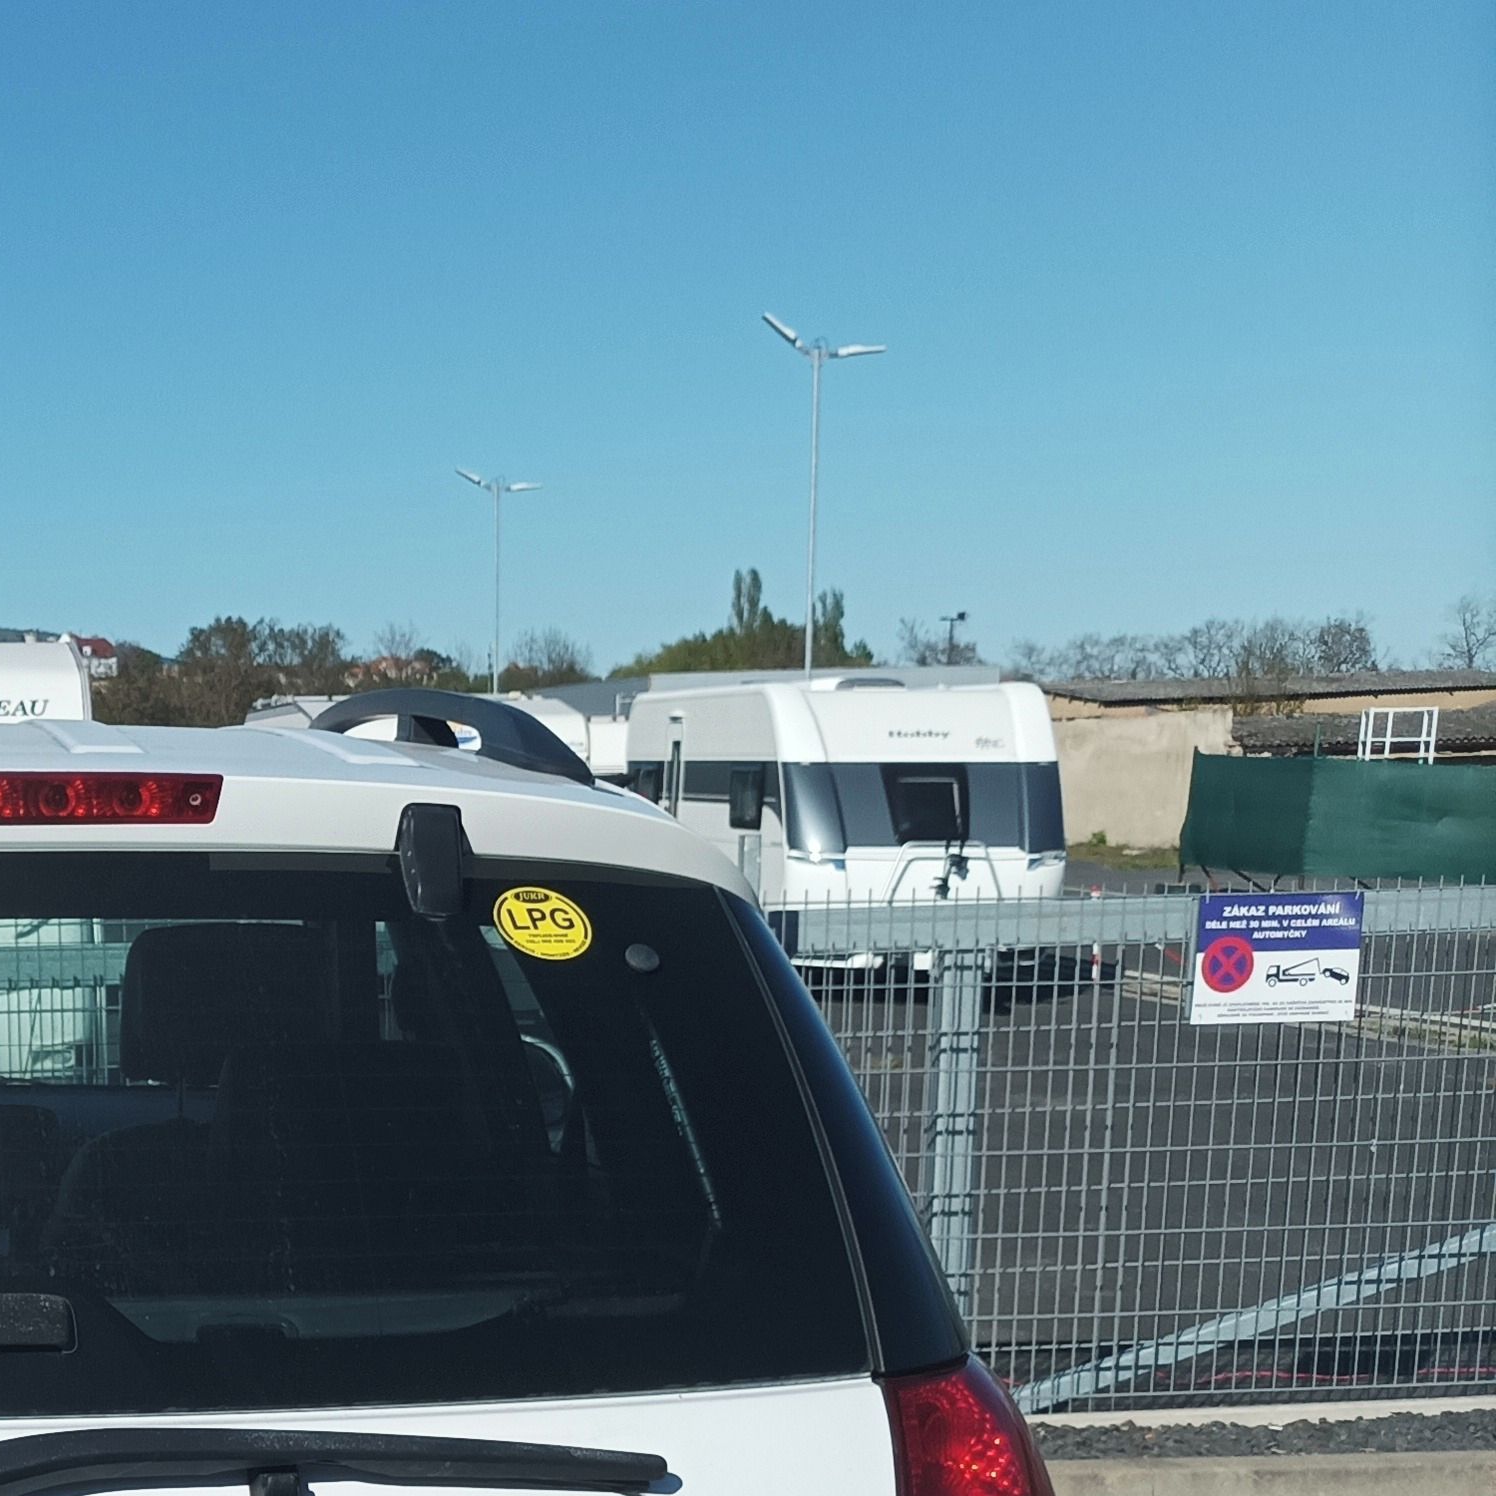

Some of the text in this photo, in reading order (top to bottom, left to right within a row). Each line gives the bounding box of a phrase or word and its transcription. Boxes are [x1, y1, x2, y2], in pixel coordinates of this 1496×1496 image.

[1222, 901, 1340, 917] ZÁKAZ PARKOVÁNÍ
[506, 908, 575, 930] LPG
[1249, 920, 1260, 928] 30
[1282, 919, 1289, 927] V
